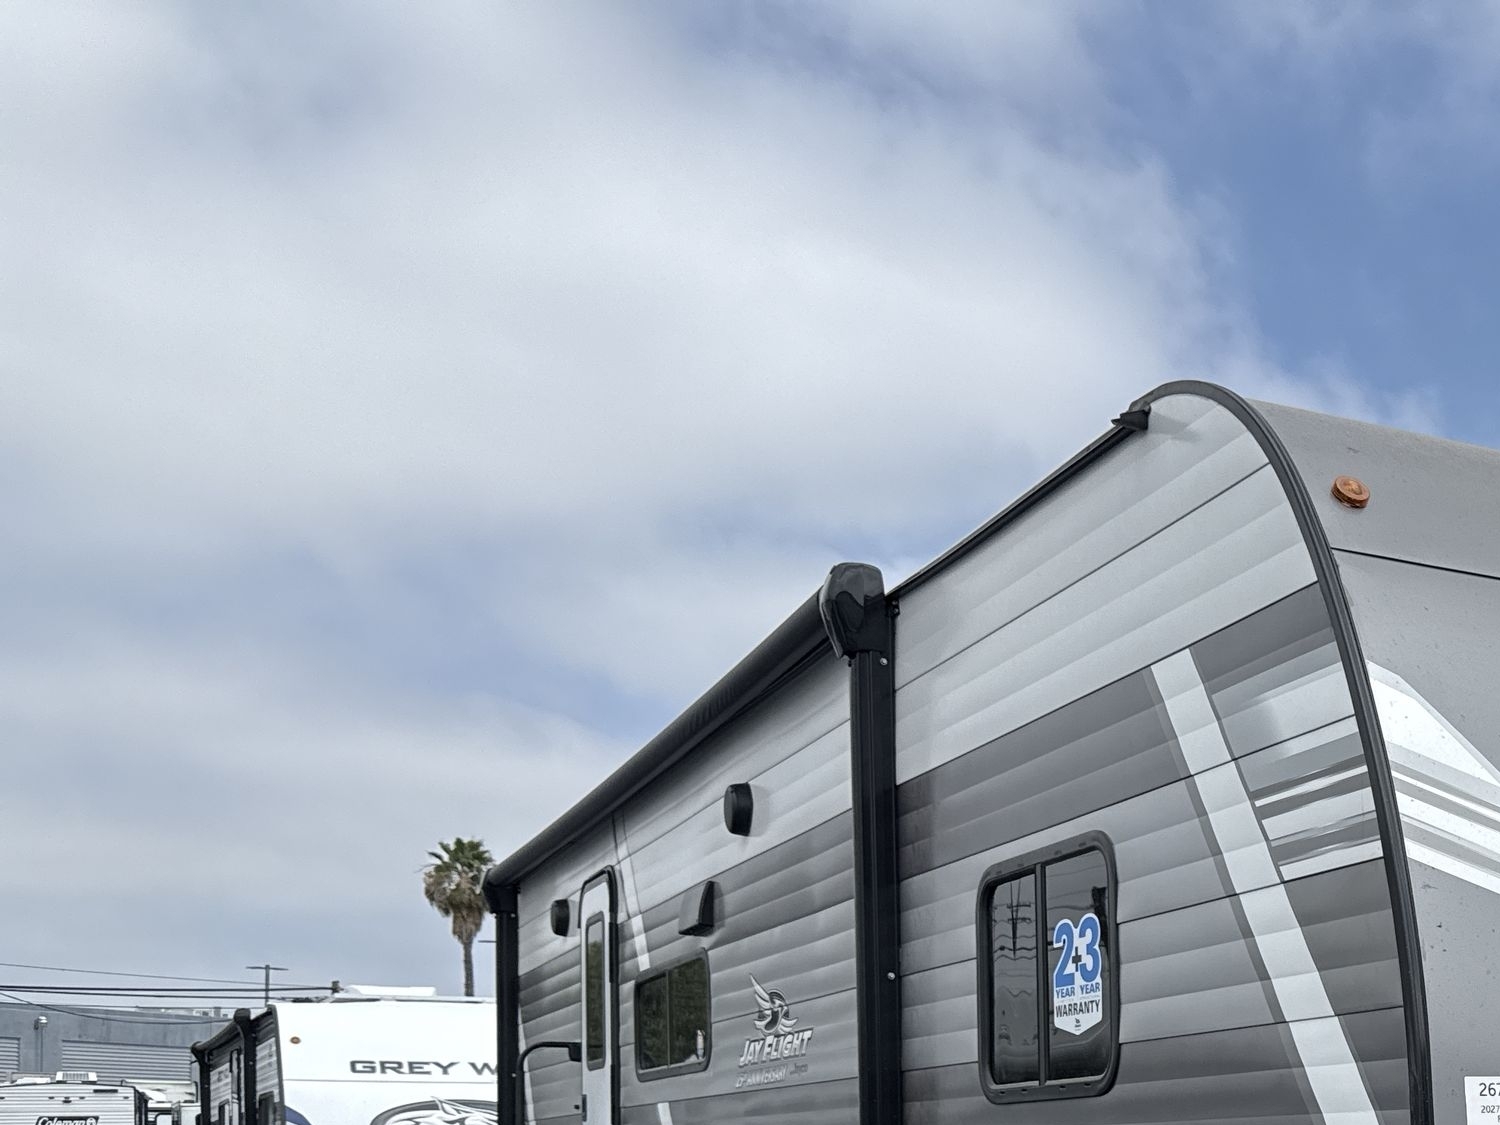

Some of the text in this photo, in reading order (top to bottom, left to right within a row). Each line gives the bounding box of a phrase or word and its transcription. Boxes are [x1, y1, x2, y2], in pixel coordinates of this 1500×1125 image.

[1055, 986, 1076, 999] YEAR
[1080, 982, 1101, 995] YEAR
[1055, 999, 1101, 1018] WARRANTY
[739, 1029, 813, 1067] JAY FLIGHT
[350, 1060, 460, 1075] GREY
[1480, 1104, 1500, 1114] 2027
